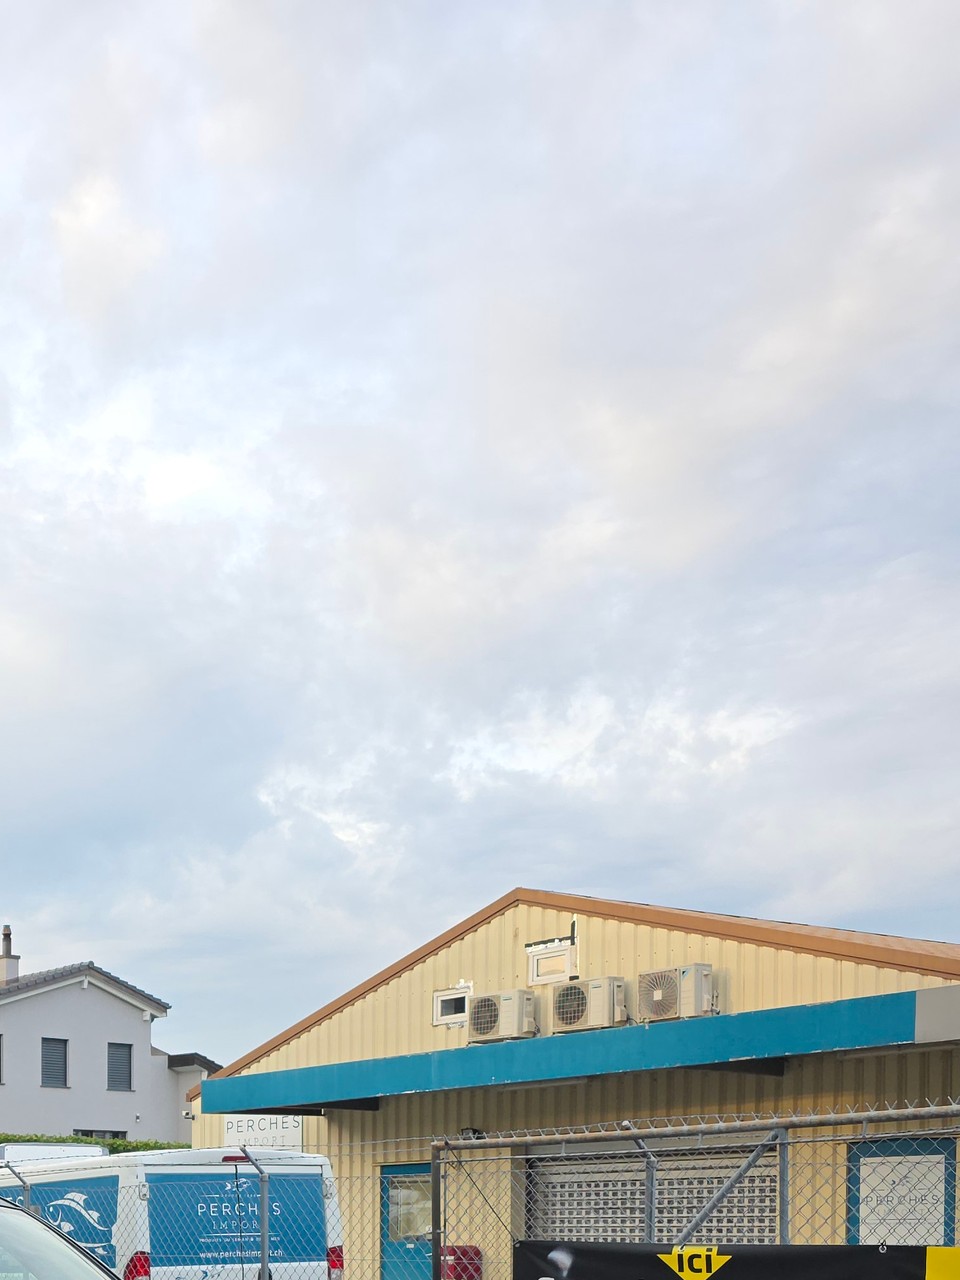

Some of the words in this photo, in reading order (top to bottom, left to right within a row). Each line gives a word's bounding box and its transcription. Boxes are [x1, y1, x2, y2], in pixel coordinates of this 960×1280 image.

[226, 1115, 301, 1133] PERCHES
[197, 1202, 281, 1216] PERCHS
[677, 1248, 713, 1274] ici
